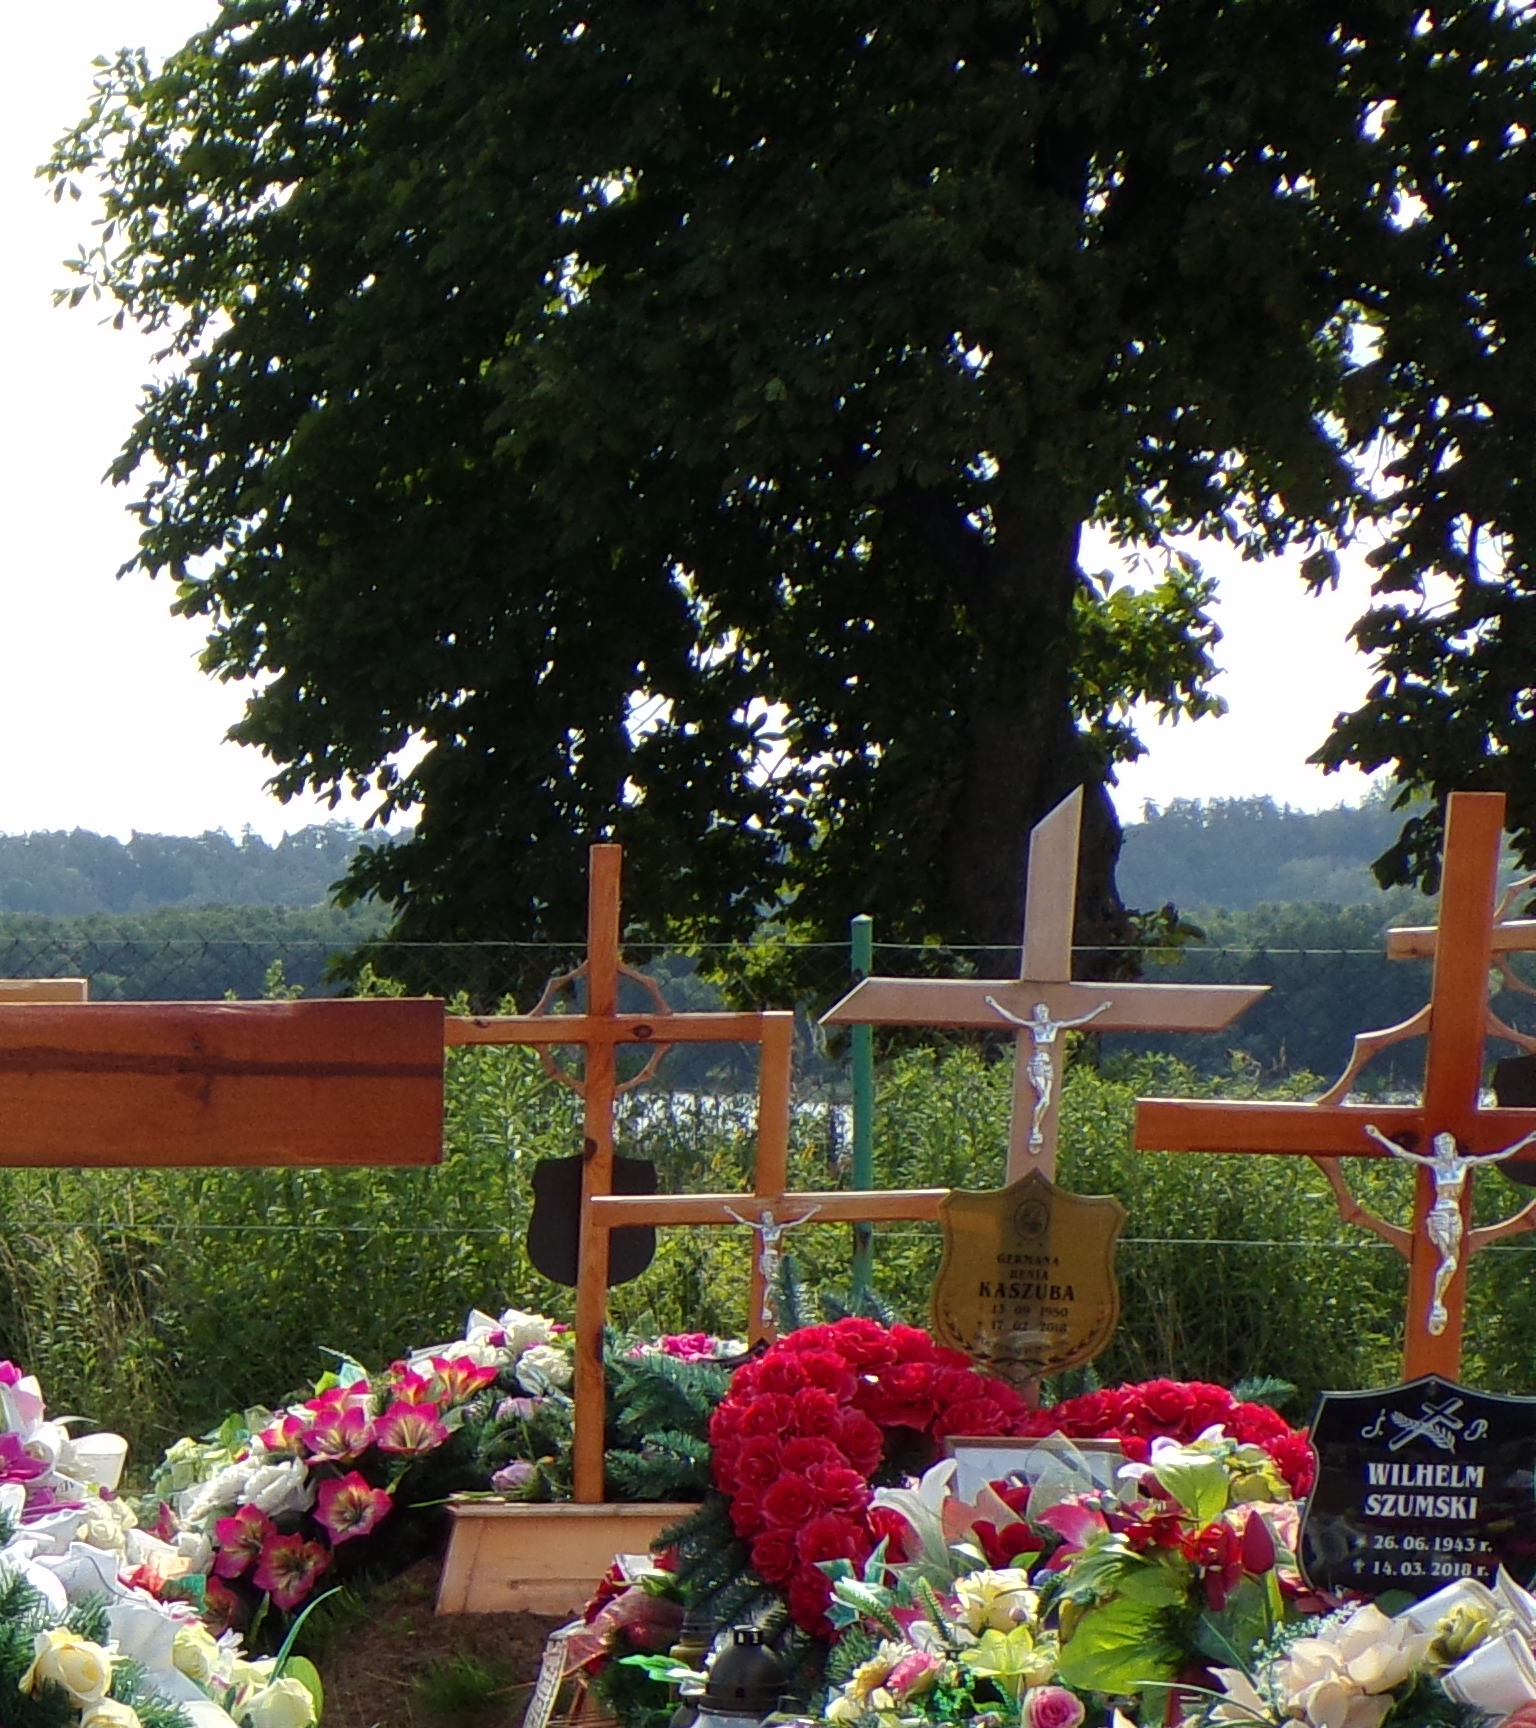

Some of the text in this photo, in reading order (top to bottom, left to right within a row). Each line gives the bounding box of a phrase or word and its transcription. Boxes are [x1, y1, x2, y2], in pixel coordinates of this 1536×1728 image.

[979, 1281, 1075, 1301] KASZUBA
[1463, 1419, 1488, 1441] P.
[1367, 1462, 1485, 1488] WILHELM
[1364, 1494, 1479, 1520] SZUMSKI
[1434, 1536, 1476, 1552] 1943
[1431, 1562, 1472, 1577] 2018
